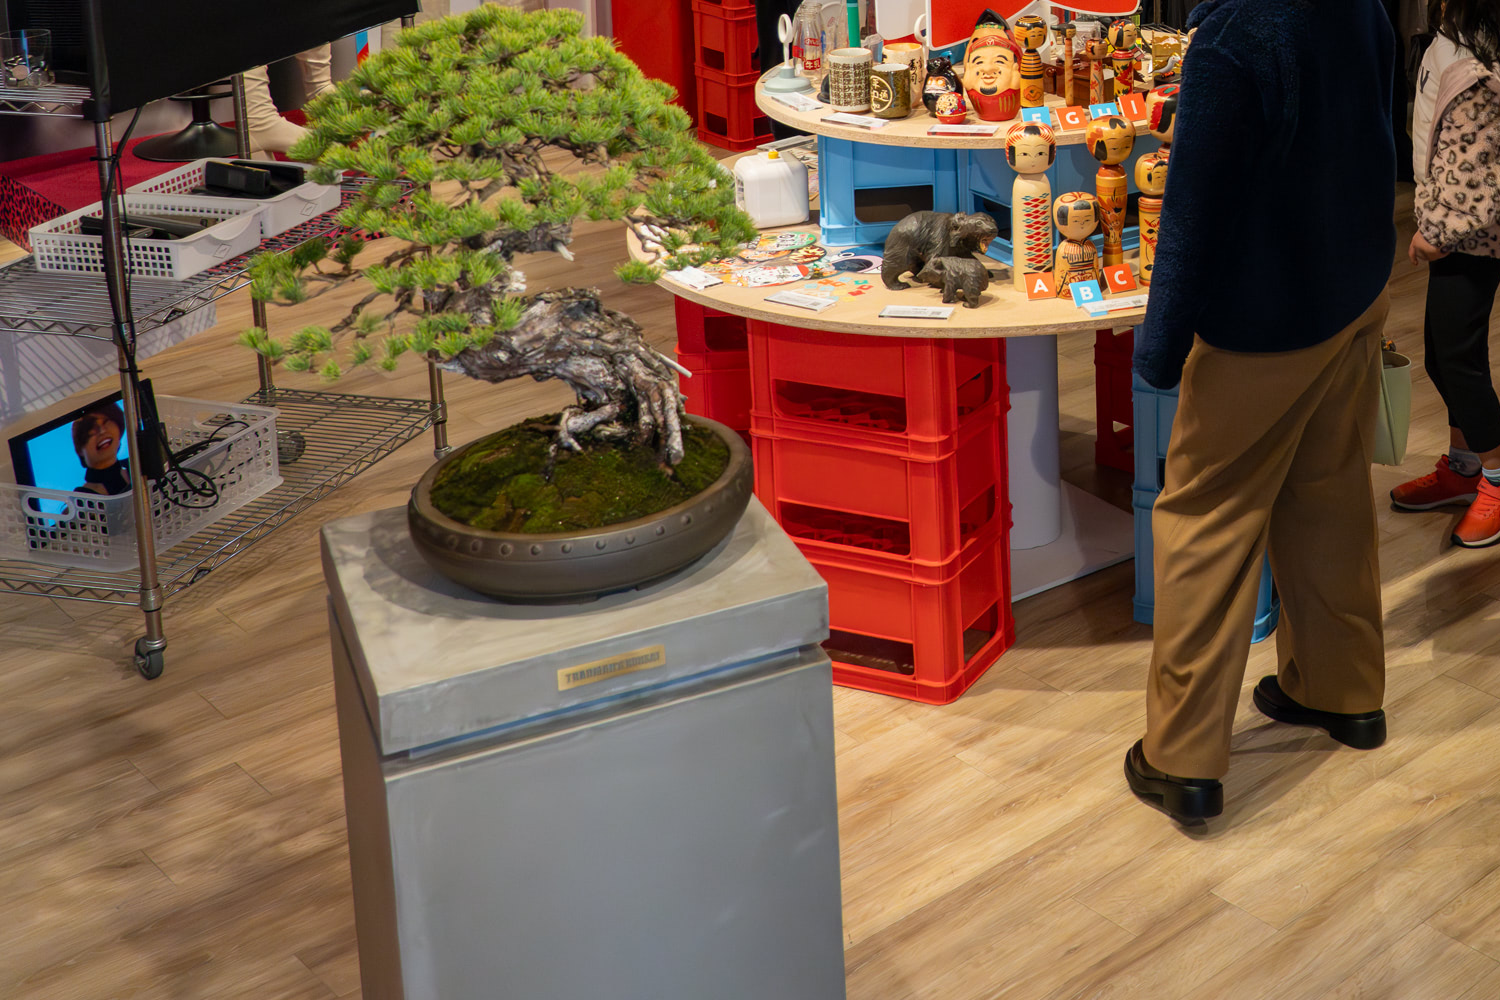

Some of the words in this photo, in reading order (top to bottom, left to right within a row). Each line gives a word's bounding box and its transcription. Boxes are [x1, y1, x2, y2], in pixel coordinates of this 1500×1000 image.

[1065, 111, 1079, 124] G
[1114, 270, 1127, 285] C
[1033, 279, 1048, 293] A
[1081, 286, 1094, 300] B
